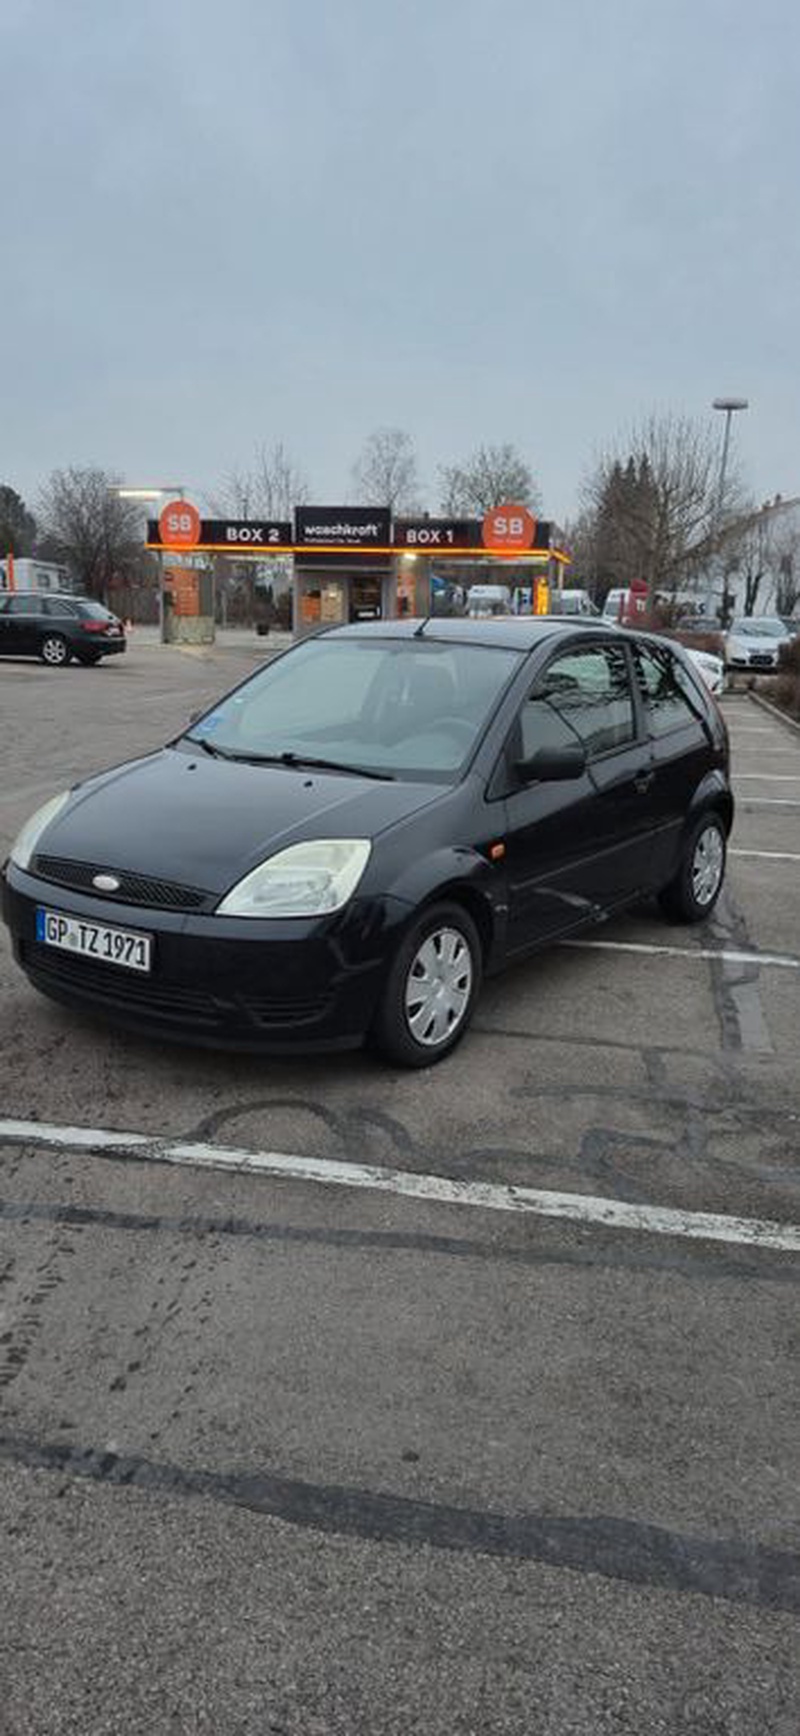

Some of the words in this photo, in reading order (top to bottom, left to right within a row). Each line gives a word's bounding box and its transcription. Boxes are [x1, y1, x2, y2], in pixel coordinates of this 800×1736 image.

[168, 514, 191, 532] SB
[304, 523, 378, 536] waschkraft
[493, 517, 523, 535] SB
[226, 527, 263, 542] BOX
[268, 528, 280, 542] 2
[406, 530, 441, 543] BOX
[446, 530, 453, 543] 1
[47, 917, 68, 943] GP
[78, 925, 99, 954] TZ
[103, 932, 146, 966] 1971
